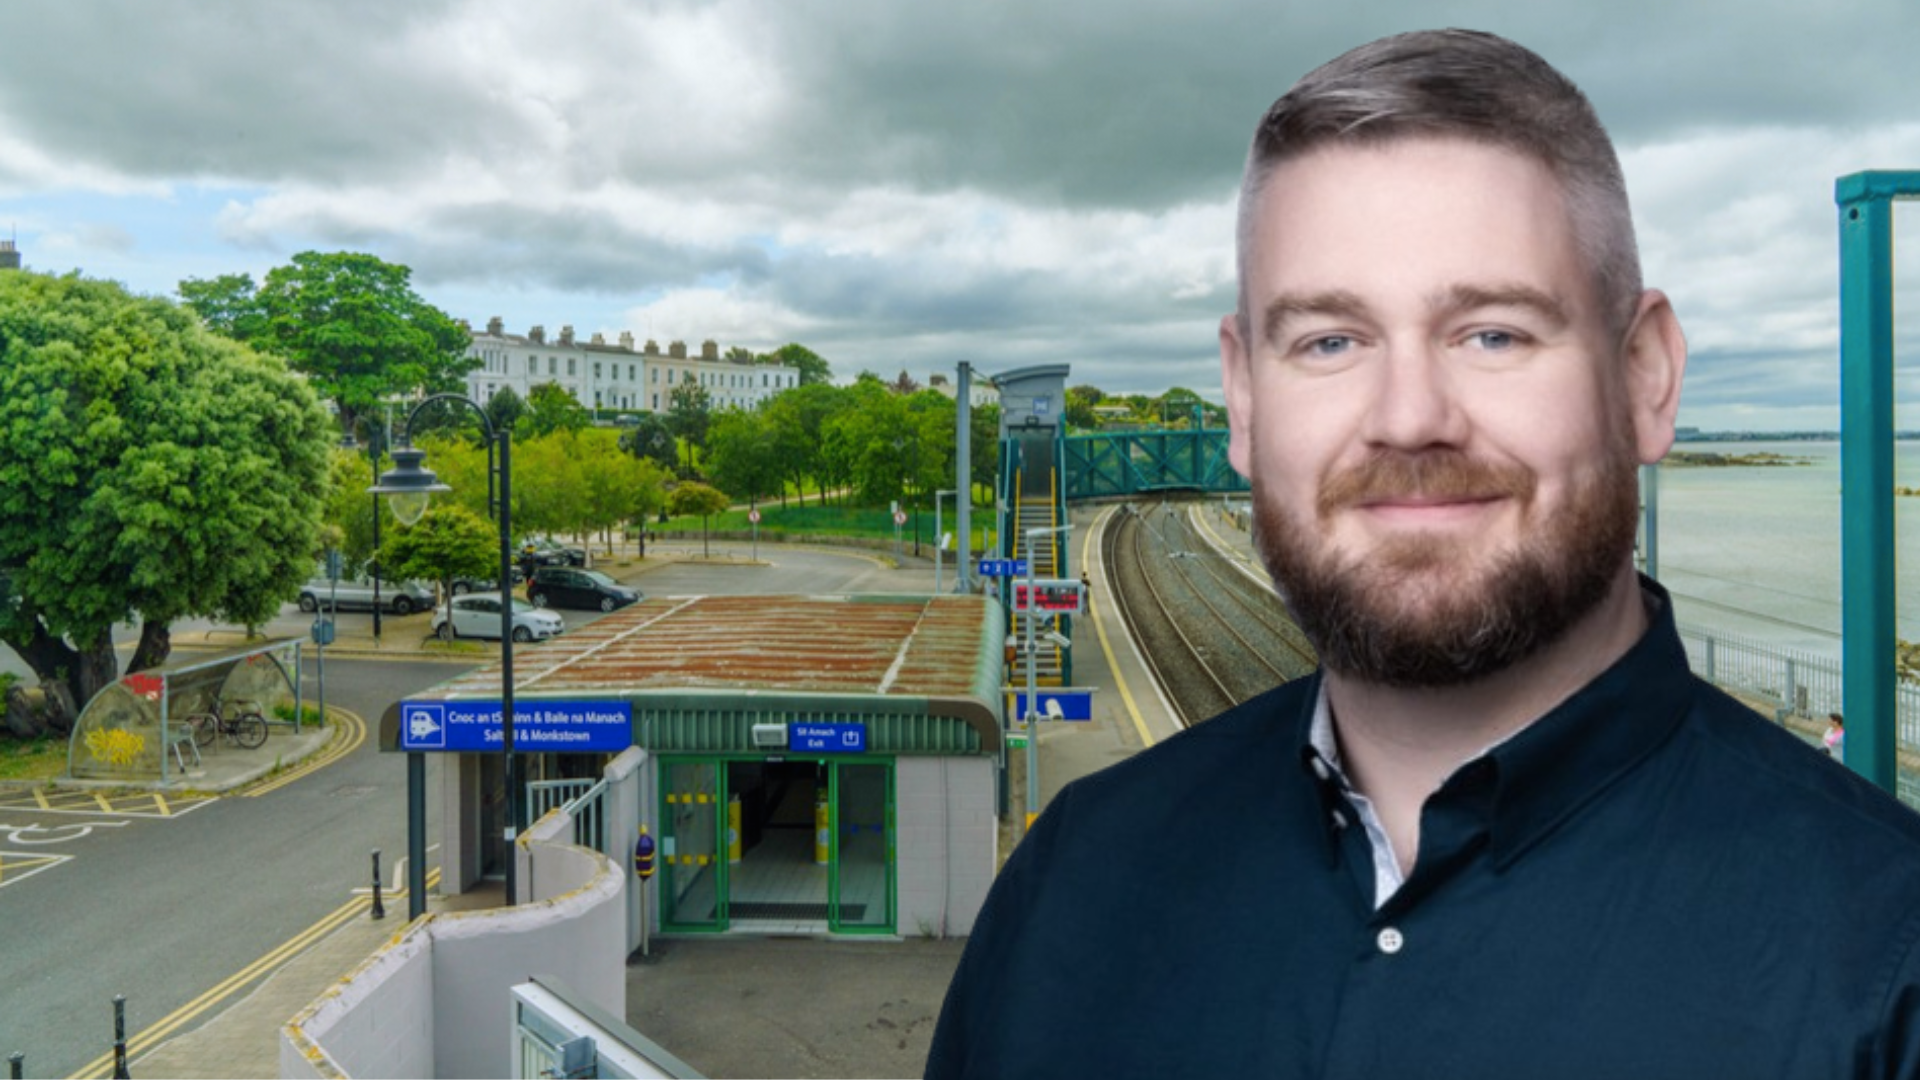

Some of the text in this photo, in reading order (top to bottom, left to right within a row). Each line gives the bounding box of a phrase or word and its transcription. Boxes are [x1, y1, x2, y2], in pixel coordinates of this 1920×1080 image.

[449, 711, 474, 724] Cnoc
[478, 713, 489, 724] an
[534, 711, 542, 724] &
[544, 711, 569, 724] Baile
[571, 713, 583, 724] na
[585, 711, 626, 724] Manach
[520, 729, 528, 741] &
[531, 729, 590, 742] Monkstown
